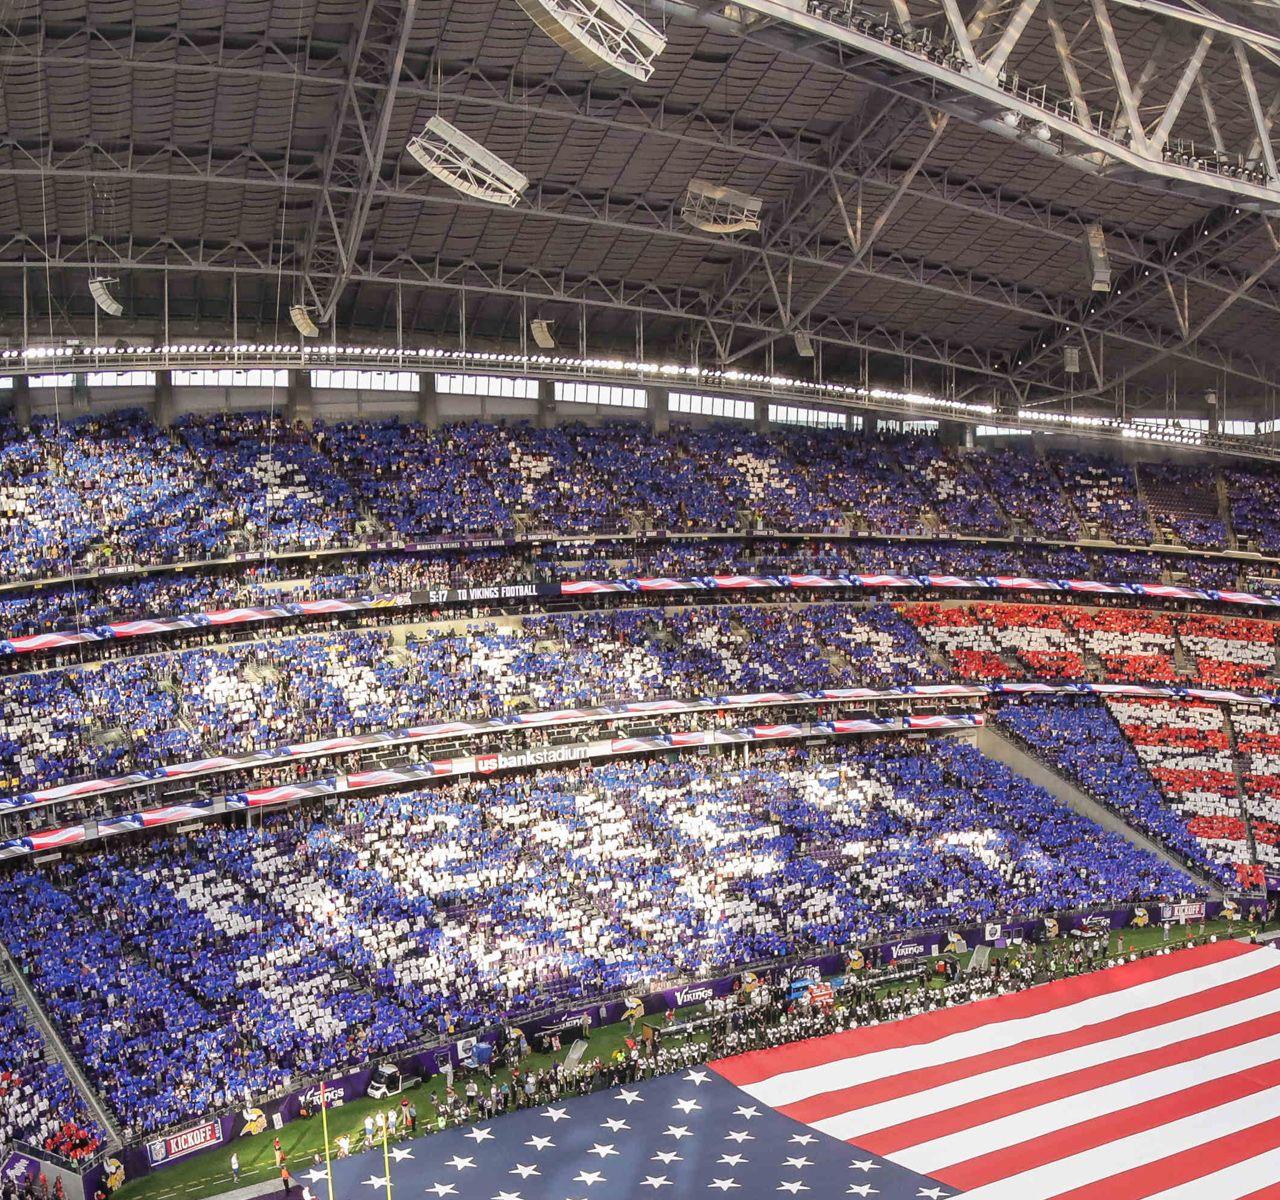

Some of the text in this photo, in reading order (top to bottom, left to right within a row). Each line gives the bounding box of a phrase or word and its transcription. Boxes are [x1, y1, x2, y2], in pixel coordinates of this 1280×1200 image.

[429, 584, 538, 602] 5:17 TO VIKINGS FOOTBALL
[890, 942, 925, 958] VIKINGS
[674, 985, 714, 1006] VIKINGS
[169, 1124, 213, 1155] KICKOFF
